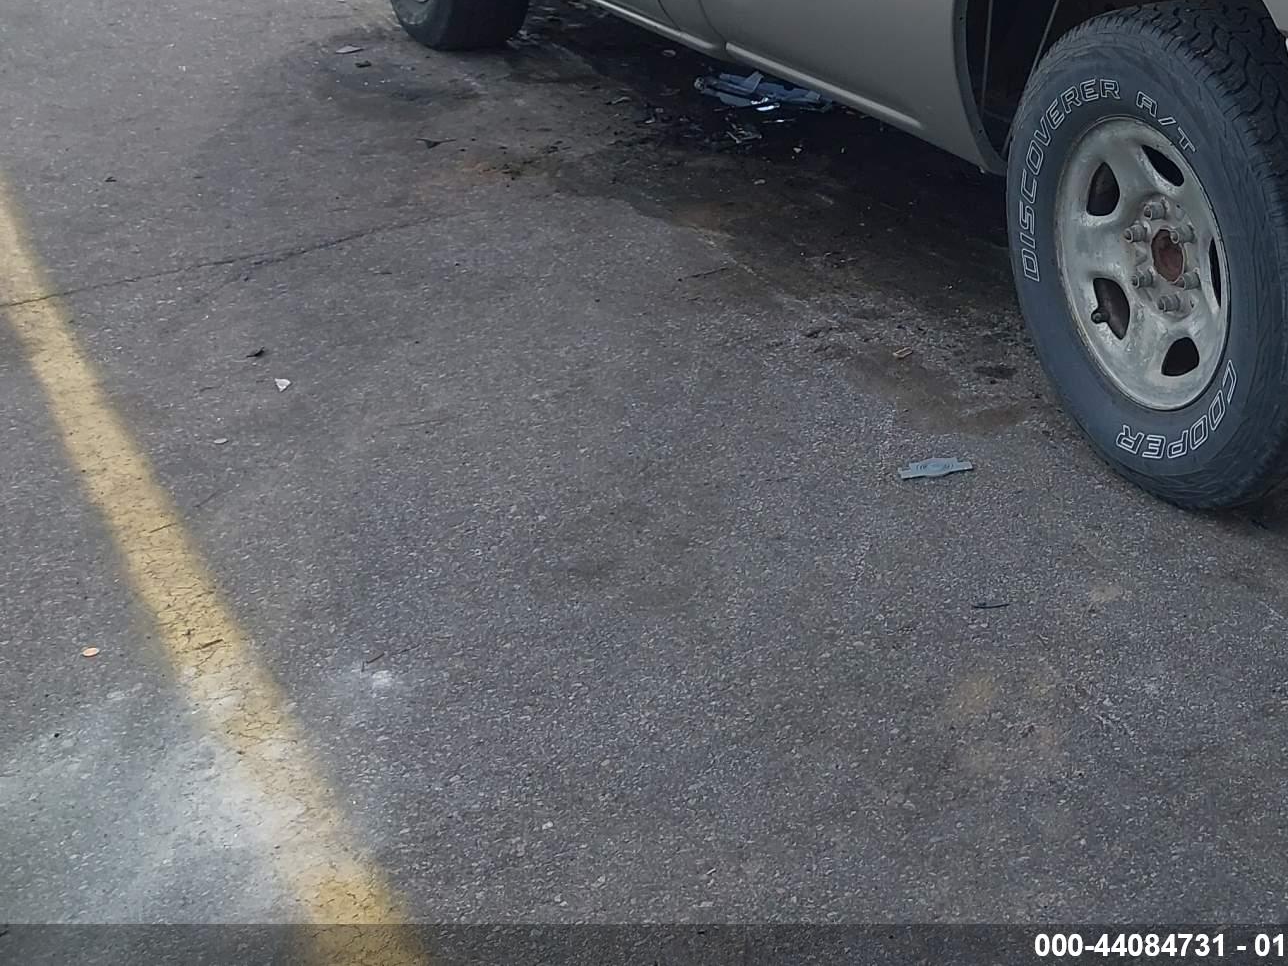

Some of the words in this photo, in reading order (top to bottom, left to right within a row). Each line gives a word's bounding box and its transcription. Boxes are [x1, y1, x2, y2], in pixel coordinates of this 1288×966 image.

[1019, 78, 1121, 282] DISCOVERER
[1135, 90, 1196, 154] A/T
[1116, 359, 1237, 459] COOPER
